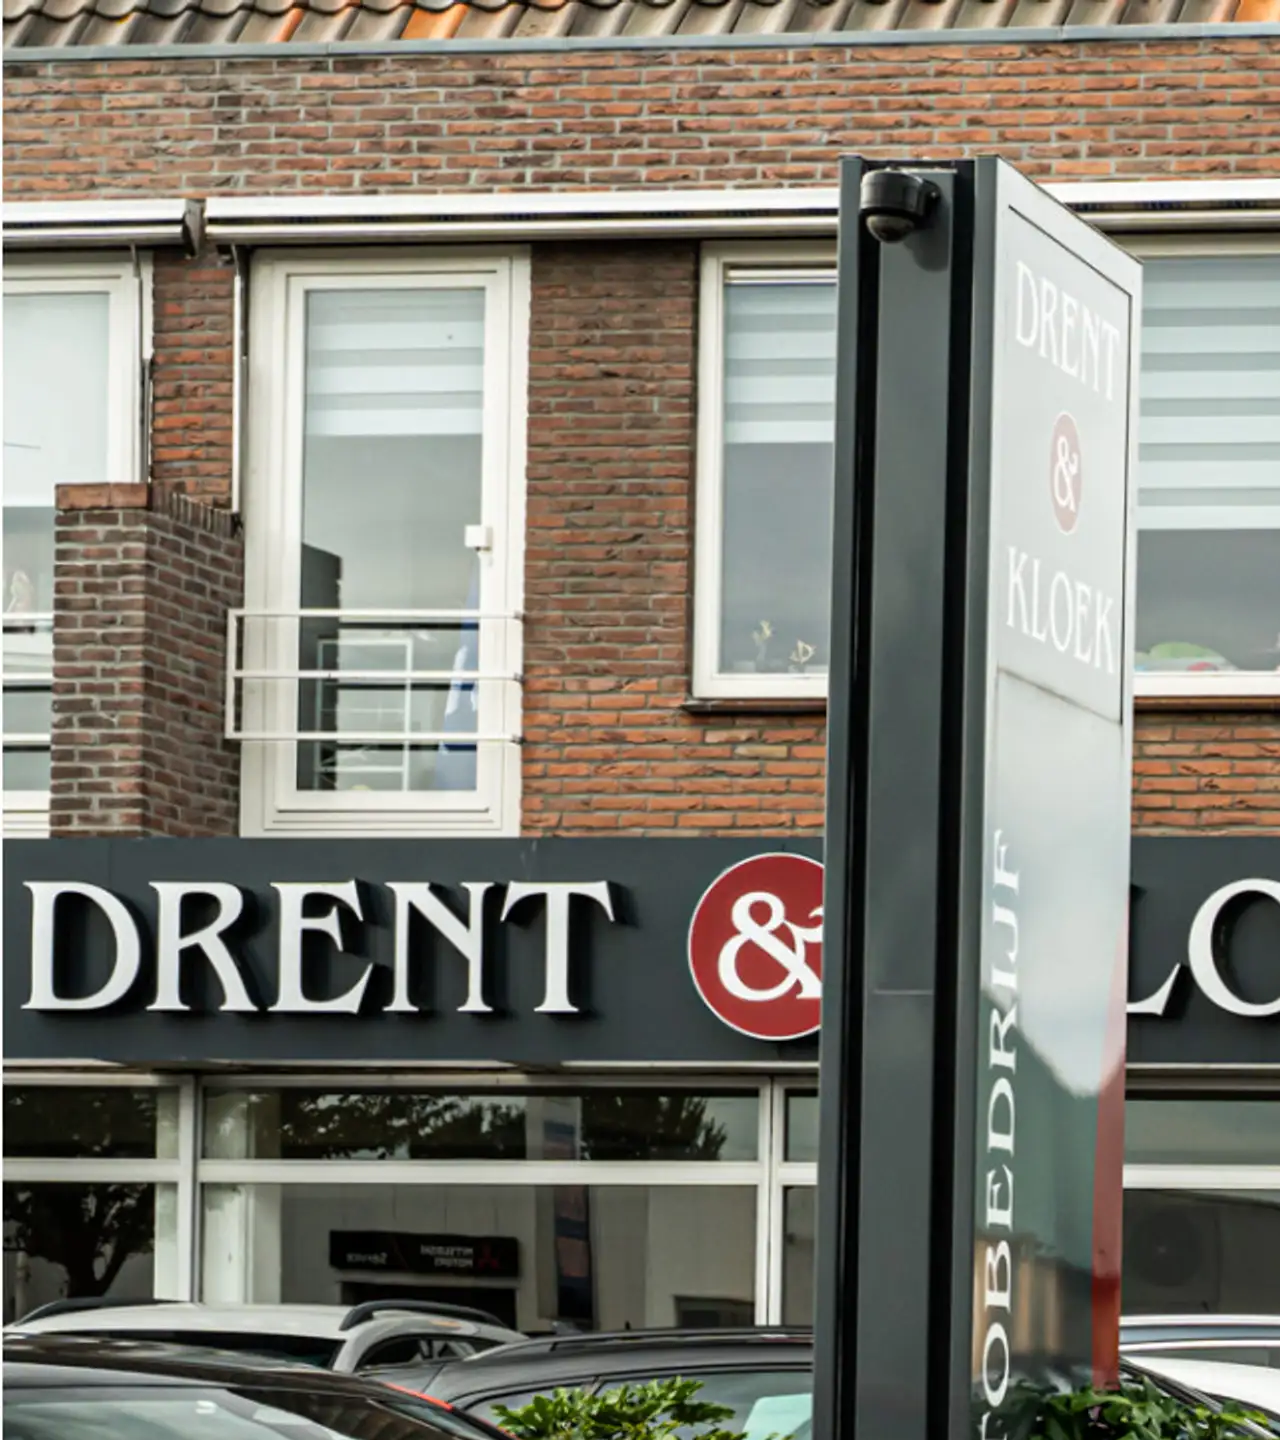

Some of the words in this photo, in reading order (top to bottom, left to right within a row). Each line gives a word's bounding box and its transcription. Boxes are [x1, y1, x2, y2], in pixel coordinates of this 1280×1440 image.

[1015, 261, 1120, 400] DRENT
[1053, 436, 1079, 513] &
[1006, 546, 1115, 674] KLOEK
[20, 880, 617, 1014] DRENT
[716, 890, 825, 1002] &
